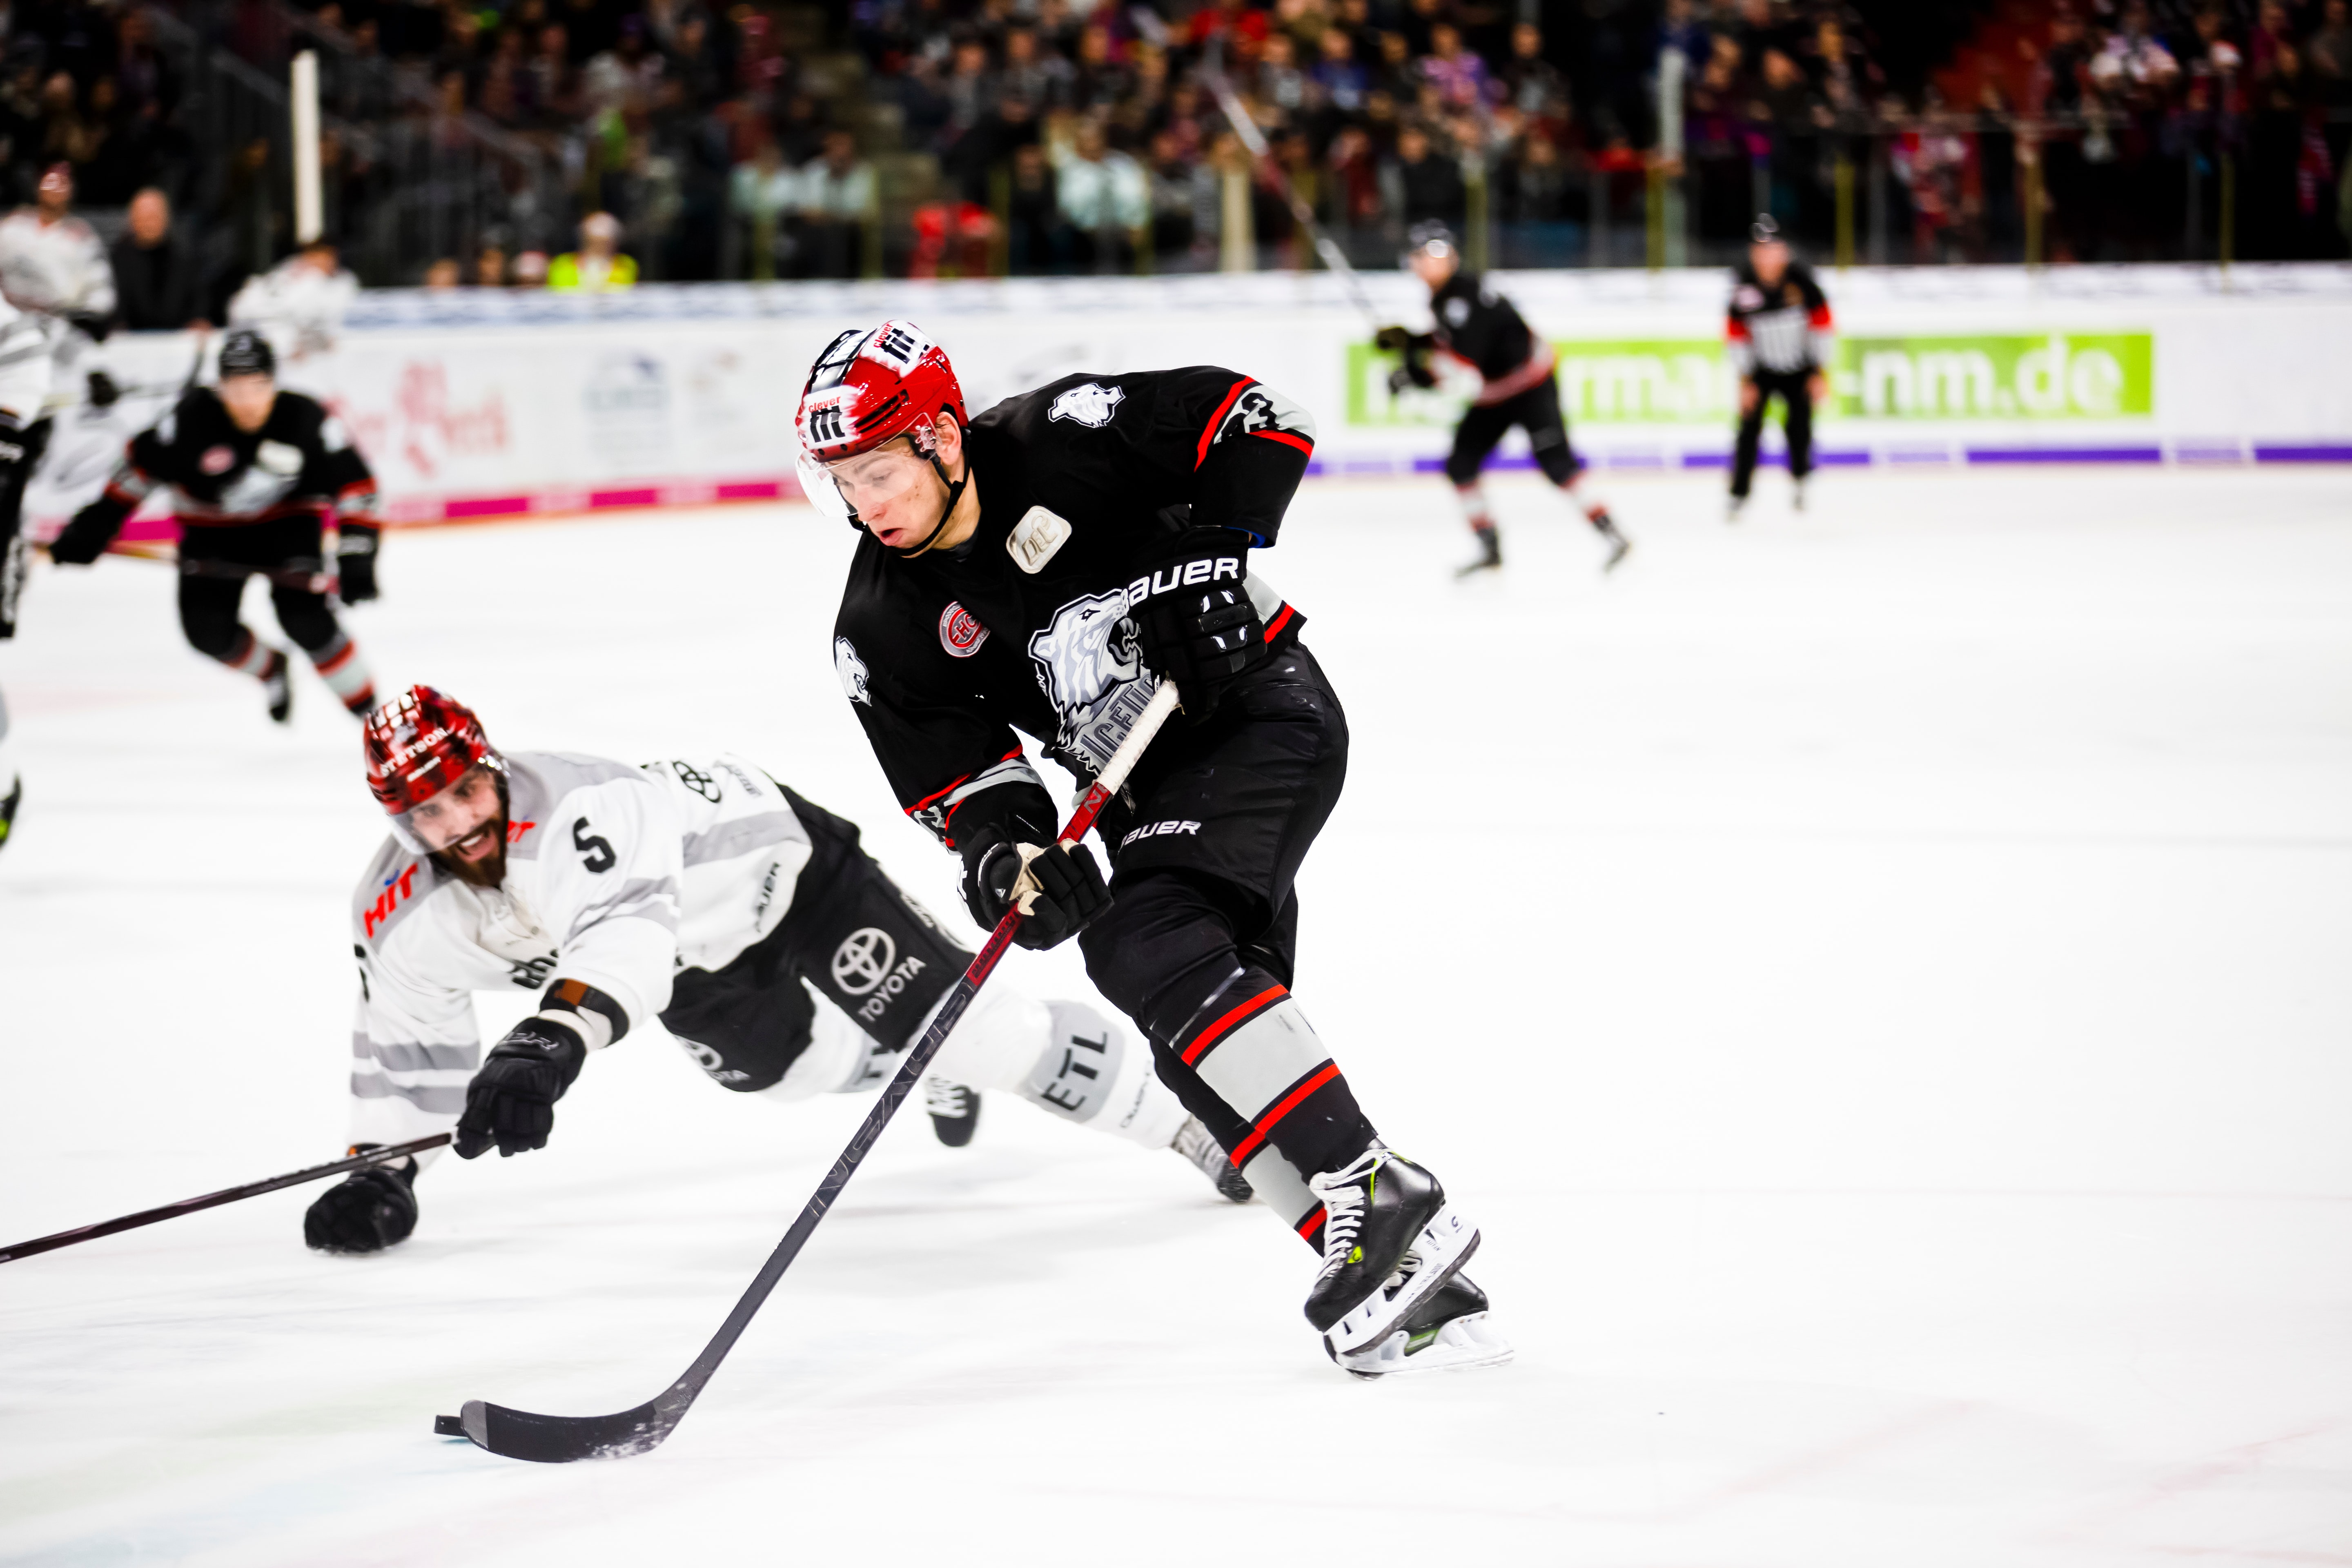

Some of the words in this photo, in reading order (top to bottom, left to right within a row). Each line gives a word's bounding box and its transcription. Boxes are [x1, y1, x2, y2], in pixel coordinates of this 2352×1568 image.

[873, 323, 893, 348] clever
[882, 328, 915, 364] fit
[808, 395, 841, 413] clever
[810, 406, 845, 443] fit
[380, 727, 448, 777] STETSON
[573, 816, 617, 874] 5
[363, 862, 419, 938] HIT
[858, 956, 927, 1022] TOYOTA
[1042, 1031, 1109, 1111] ETL
